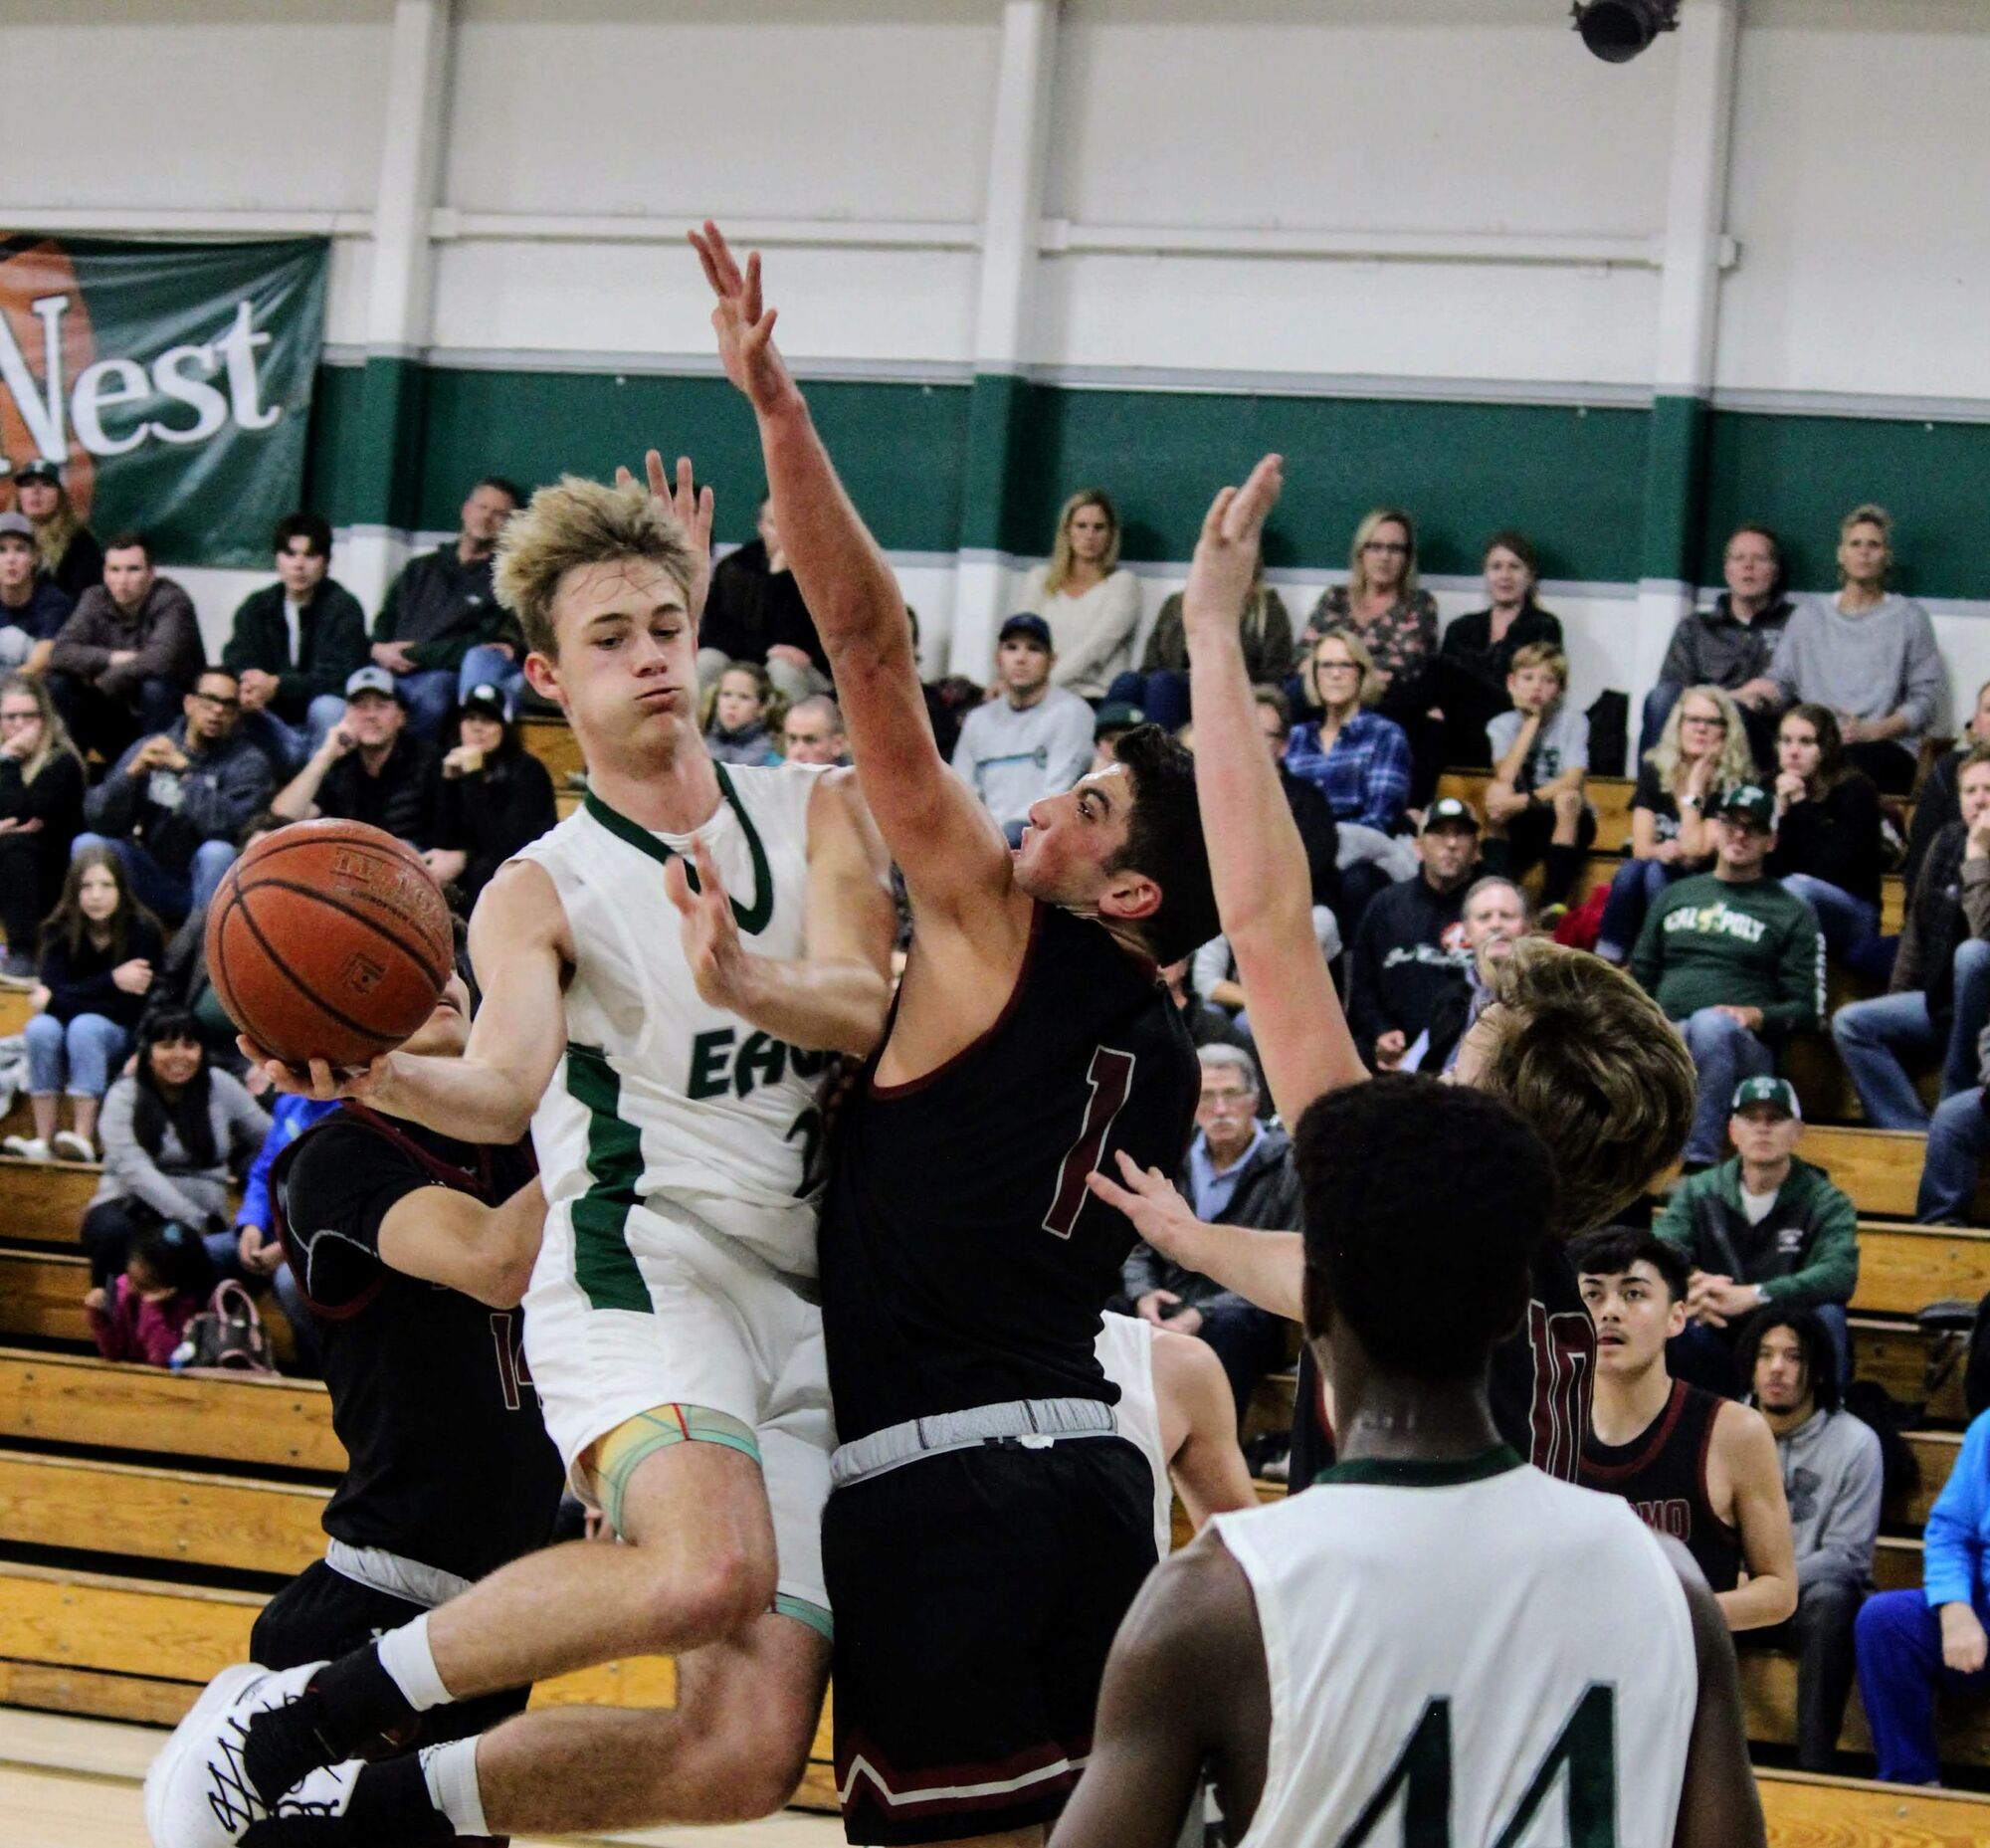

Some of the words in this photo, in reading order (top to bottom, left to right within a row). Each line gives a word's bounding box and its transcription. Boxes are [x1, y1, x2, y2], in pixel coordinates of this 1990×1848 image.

[0, 296, 281, 474] Nest
[1042, 1044, 1136, 1240] 1
[1528, 1298, 1597, 1486] 10
[1630, 1499, 1692, 1542] MO
[1334, 1680, 1617, 1848] 44
